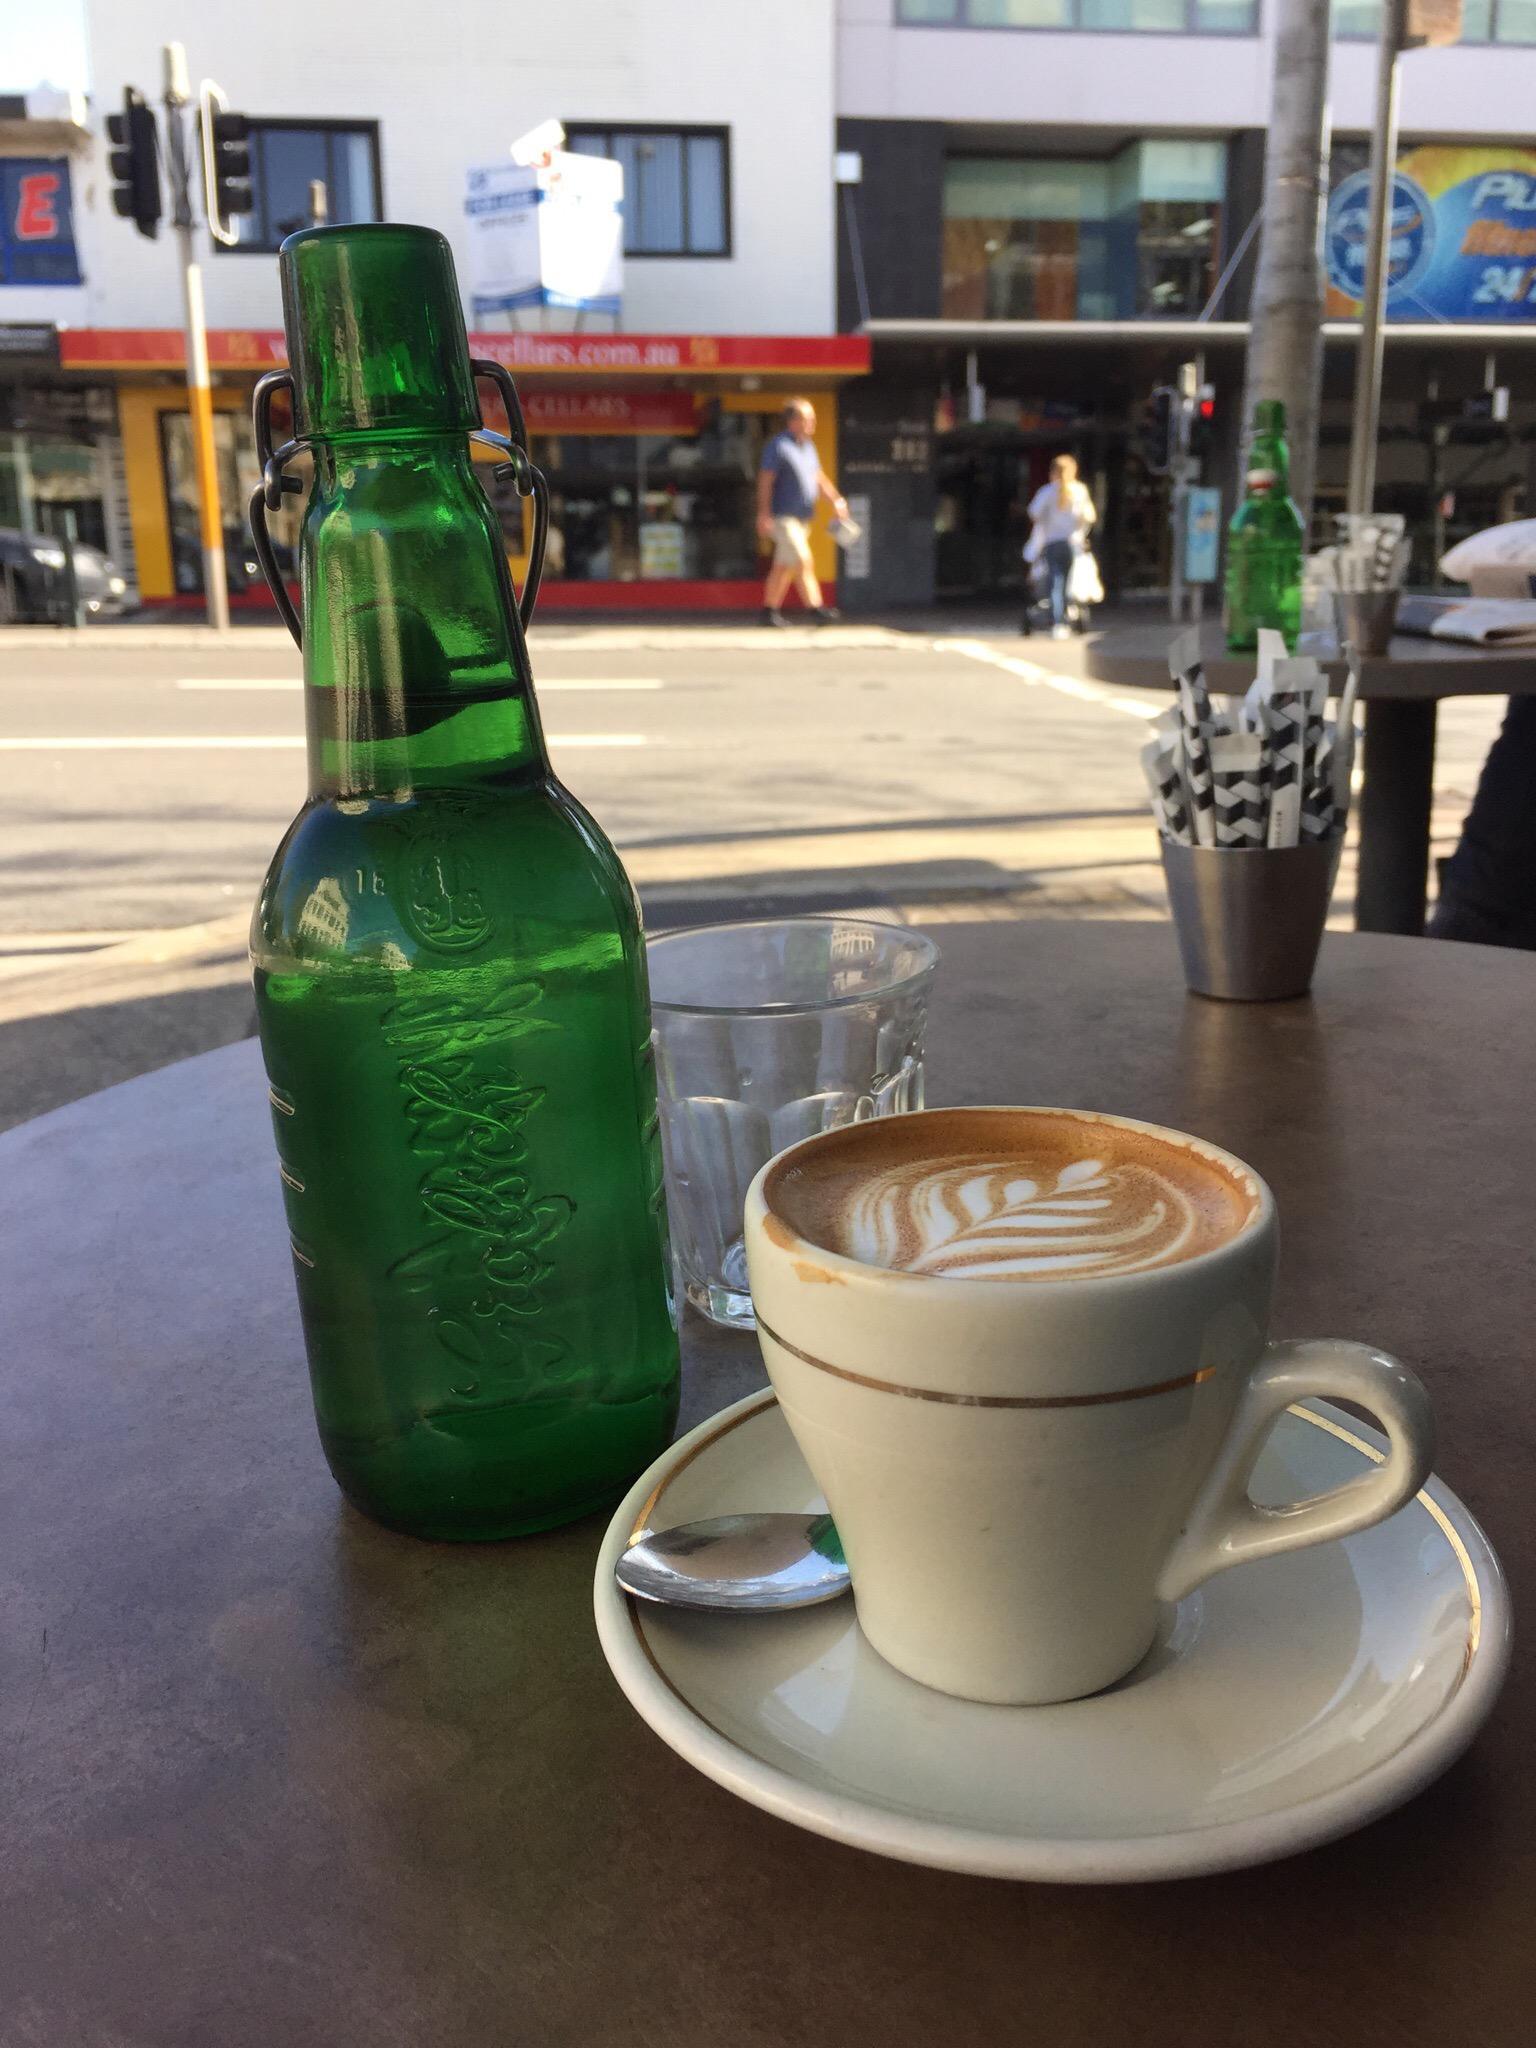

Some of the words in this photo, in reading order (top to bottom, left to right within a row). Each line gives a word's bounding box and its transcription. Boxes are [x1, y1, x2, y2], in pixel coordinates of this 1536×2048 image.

[16, 172, 60, 240] E
[1473, 266, 1536, 303] 24/
[528, 396, 630, 416] CELLARS
